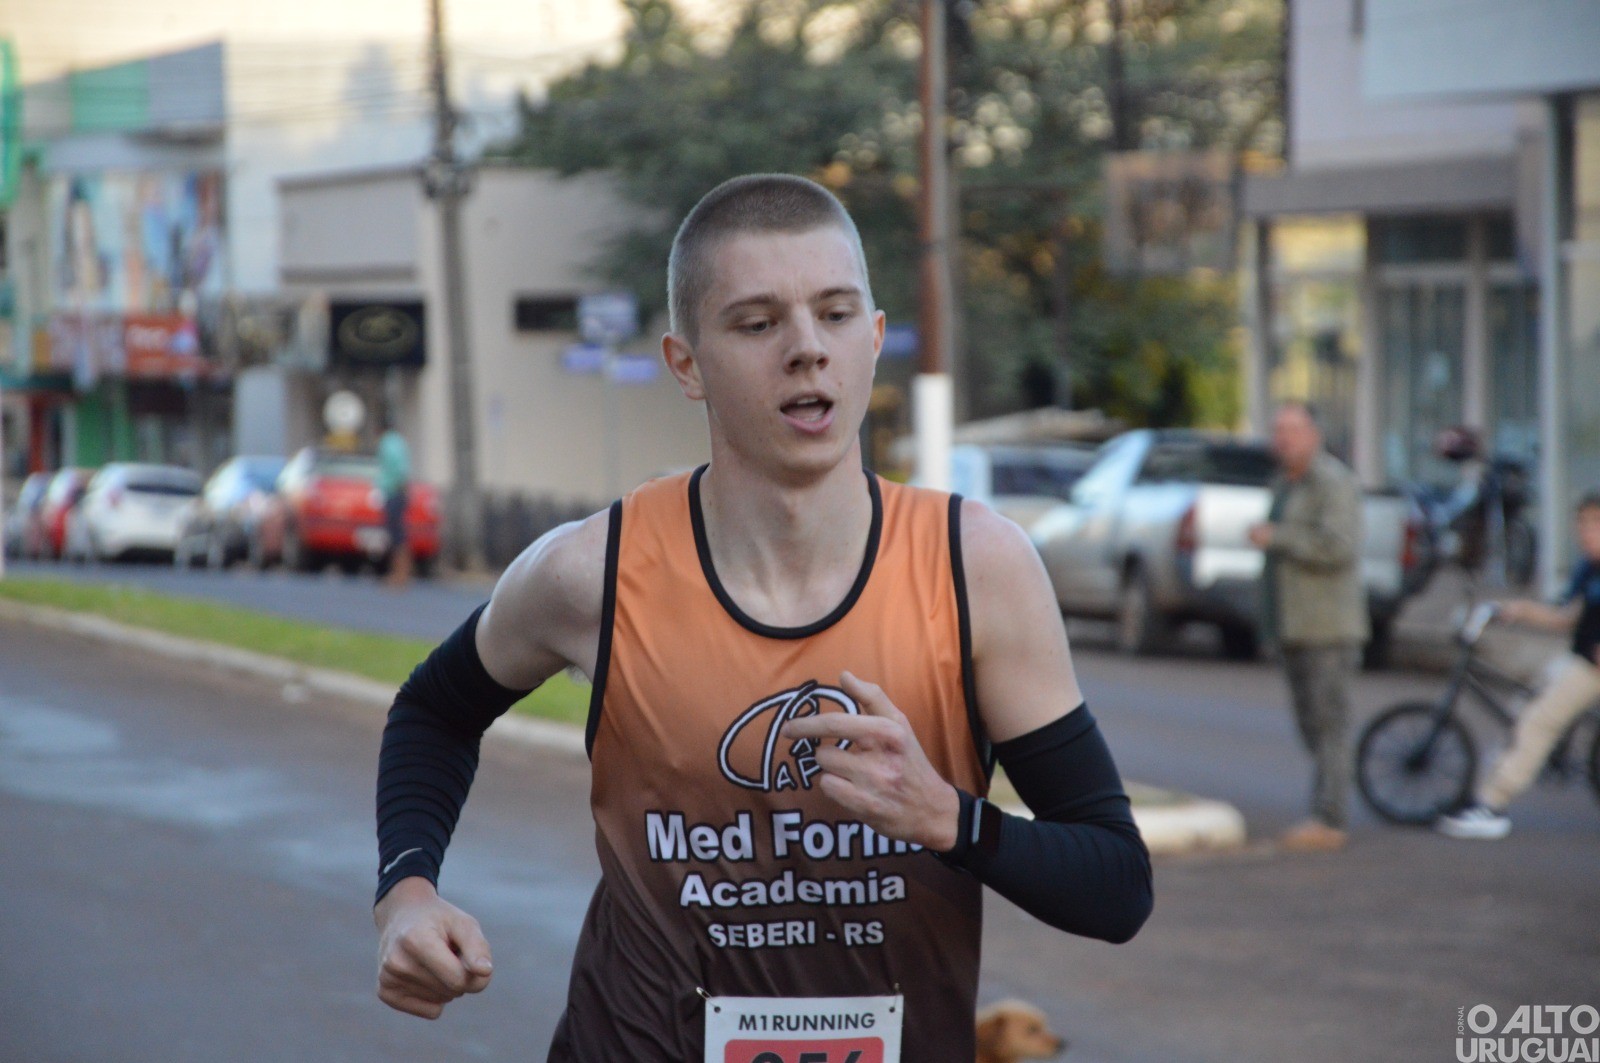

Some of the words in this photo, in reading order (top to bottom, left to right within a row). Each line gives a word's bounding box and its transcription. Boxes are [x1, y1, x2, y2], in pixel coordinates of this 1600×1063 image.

[646, 811, 754, 861] Med
[771, 811, 924, 859] Form
[679, 870, 905, 907] Academia
[707, 920, 816, 948] SEBERI
[843, 920, 885, 947] RS
[738, 1012, 876, 1032] M1RUNNING
